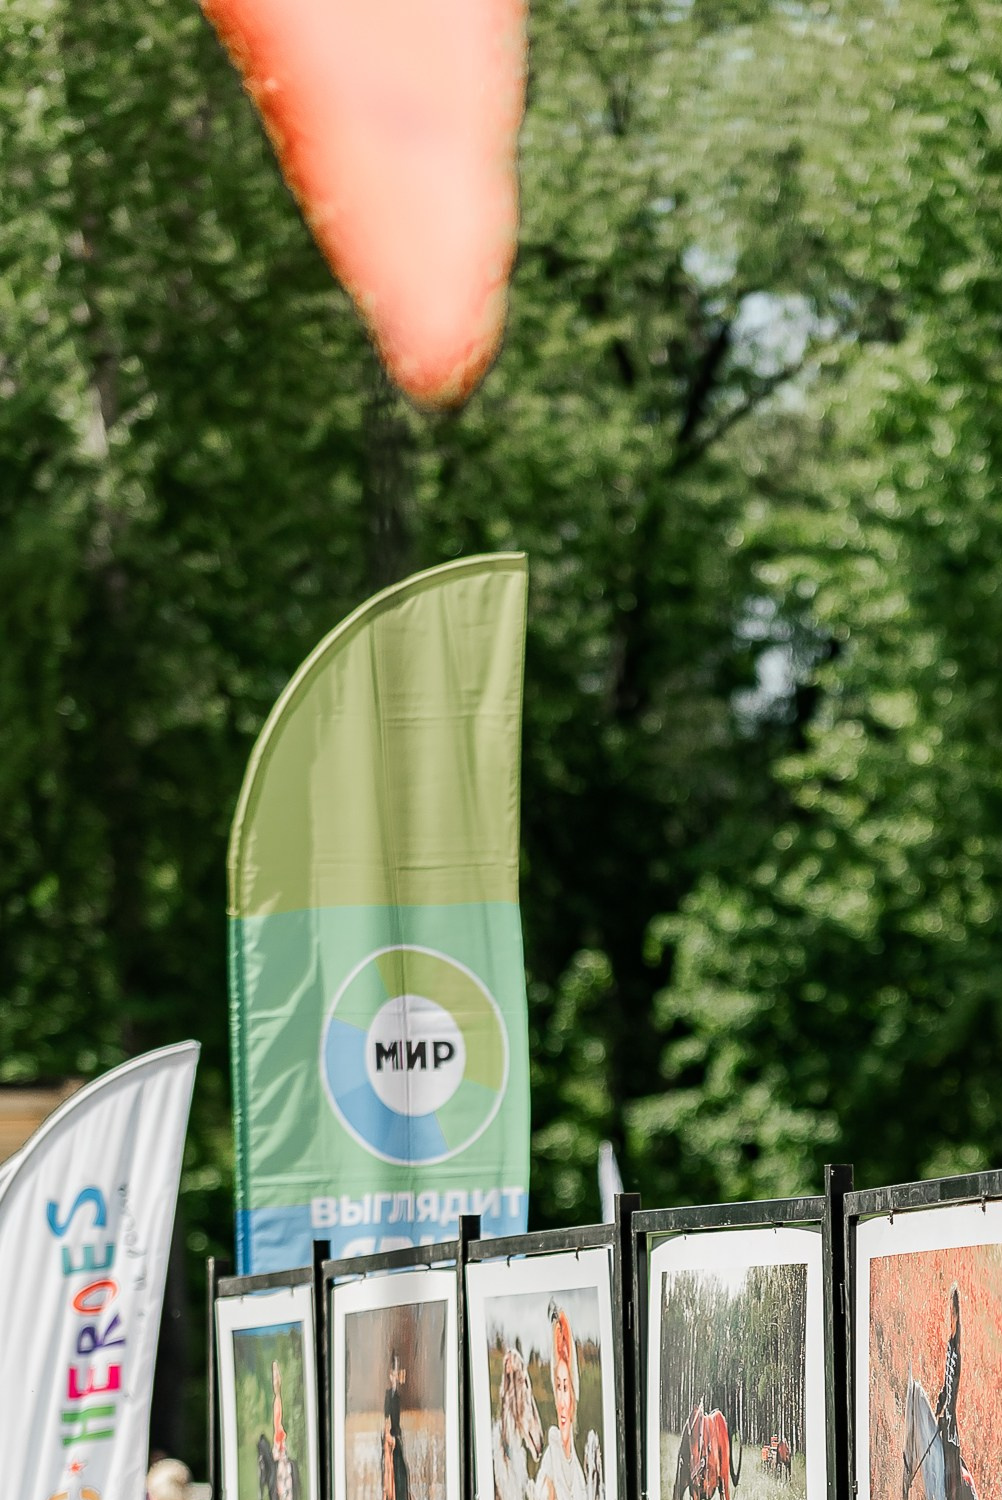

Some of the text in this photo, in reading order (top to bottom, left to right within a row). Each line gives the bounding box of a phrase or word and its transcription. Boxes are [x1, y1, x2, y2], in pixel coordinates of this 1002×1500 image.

[374, 1041, 456, 1072] МИР
[311, 1186, 525, 1229] ВЫГЛЯДИТ
[46, 1185, 126, 1448] HEROES
